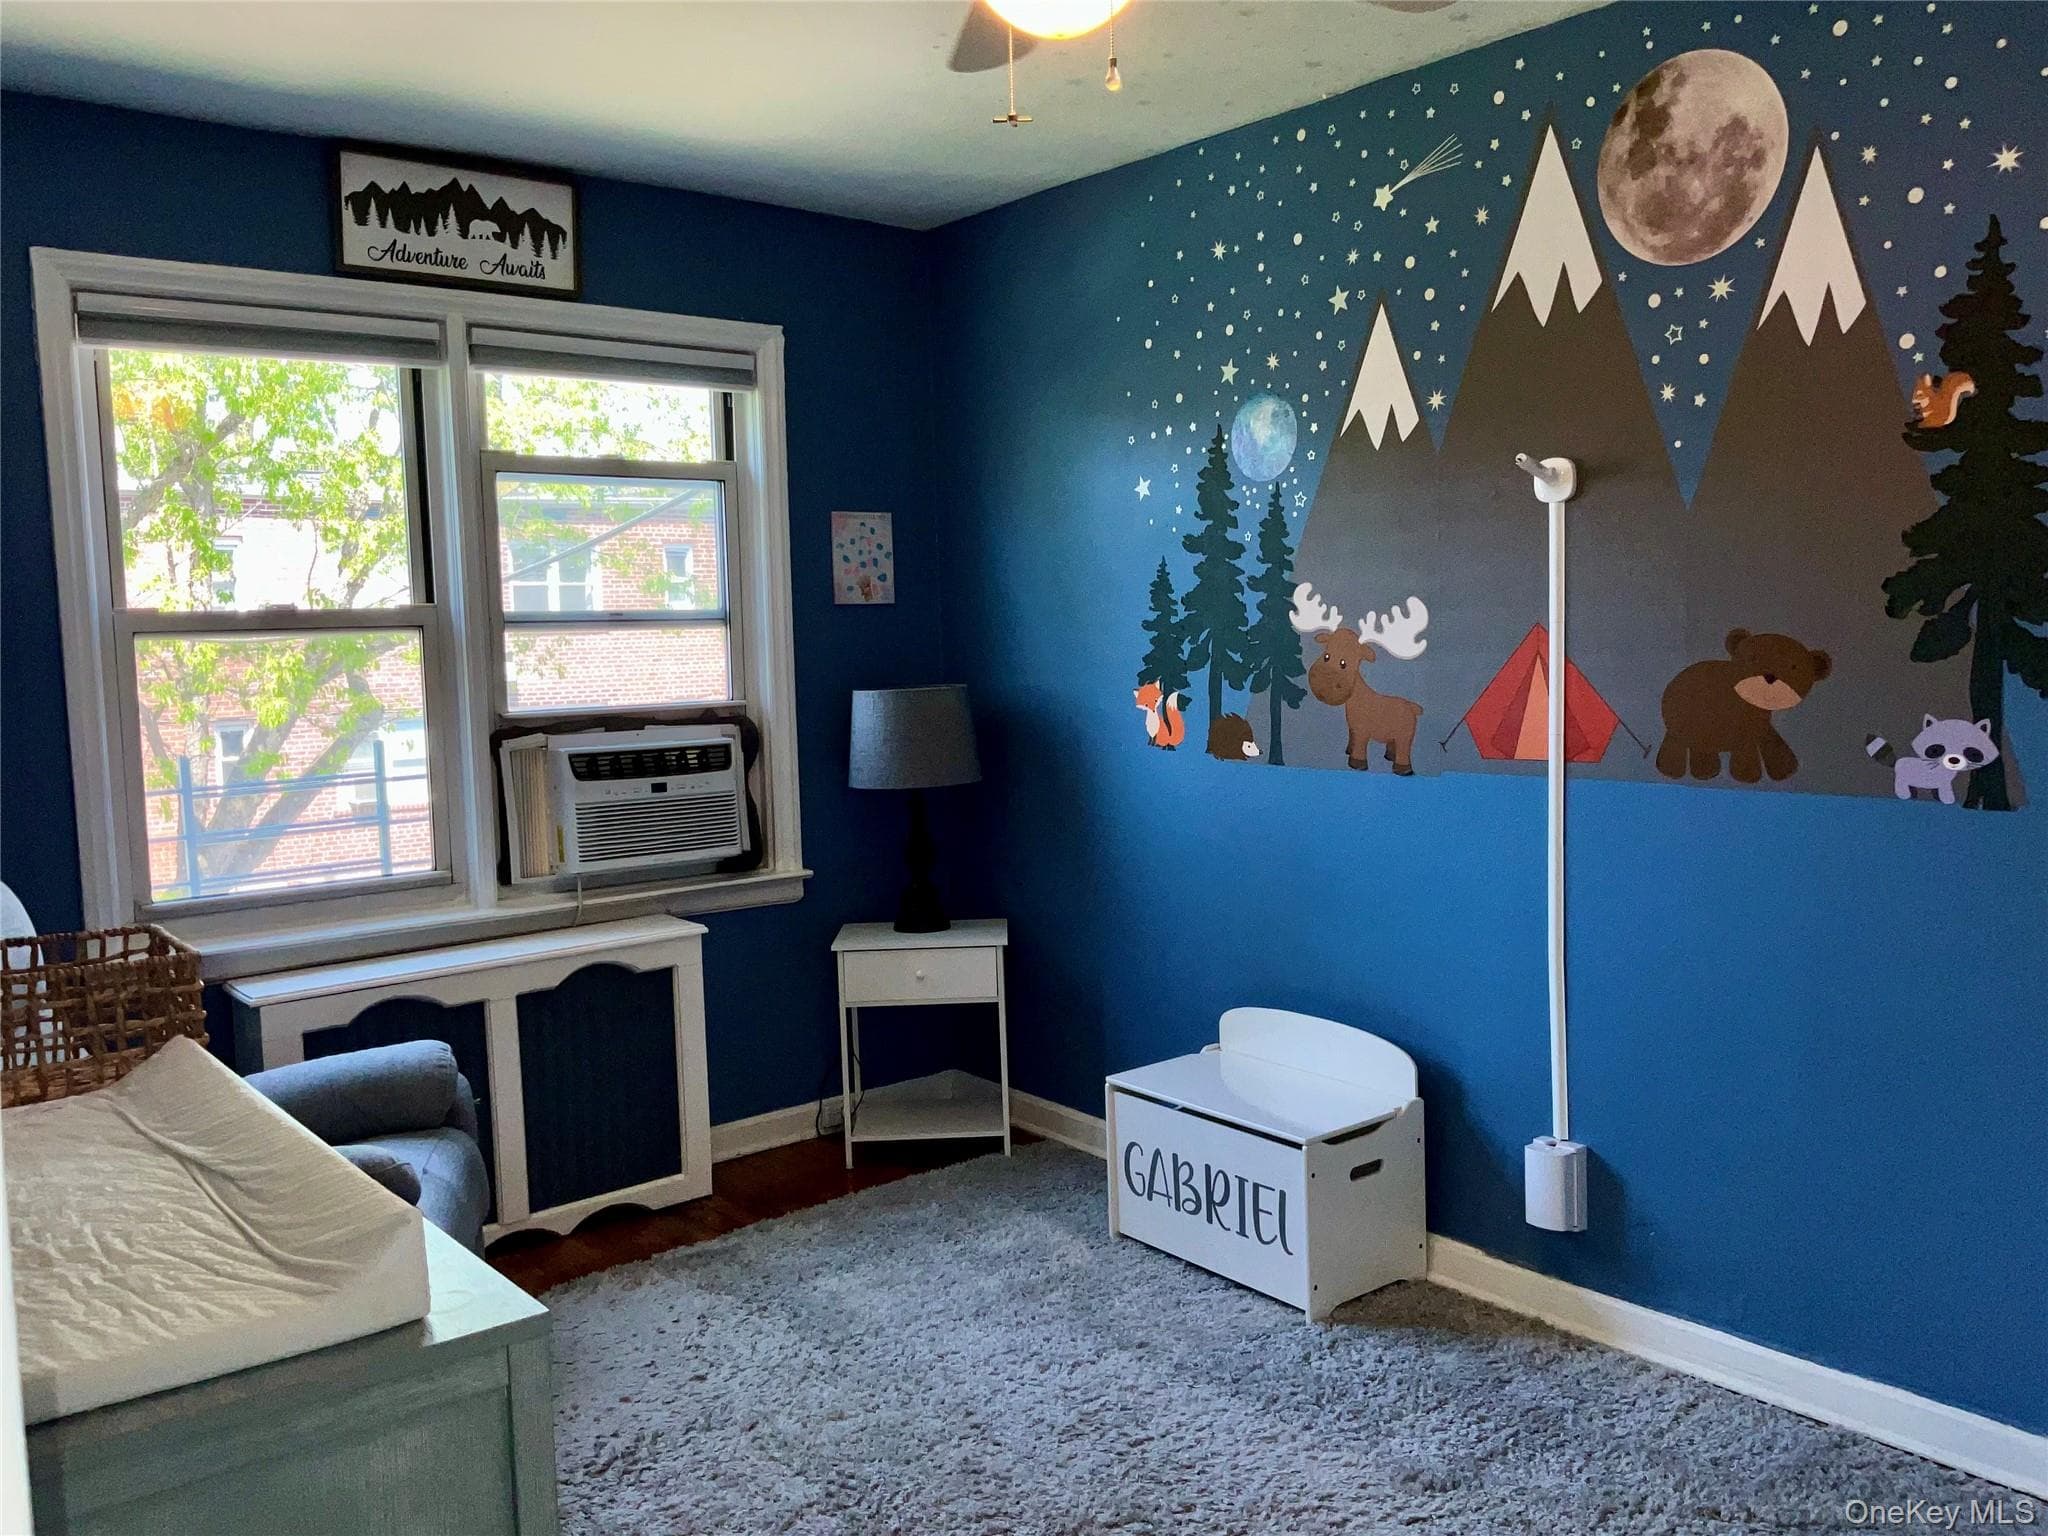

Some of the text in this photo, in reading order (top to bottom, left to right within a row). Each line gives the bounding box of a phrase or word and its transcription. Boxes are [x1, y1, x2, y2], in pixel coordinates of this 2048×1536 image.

[367, 239, 546, 280] Adventure Awaits
[1124, 1141, 1294, 1256] GABRIEL
